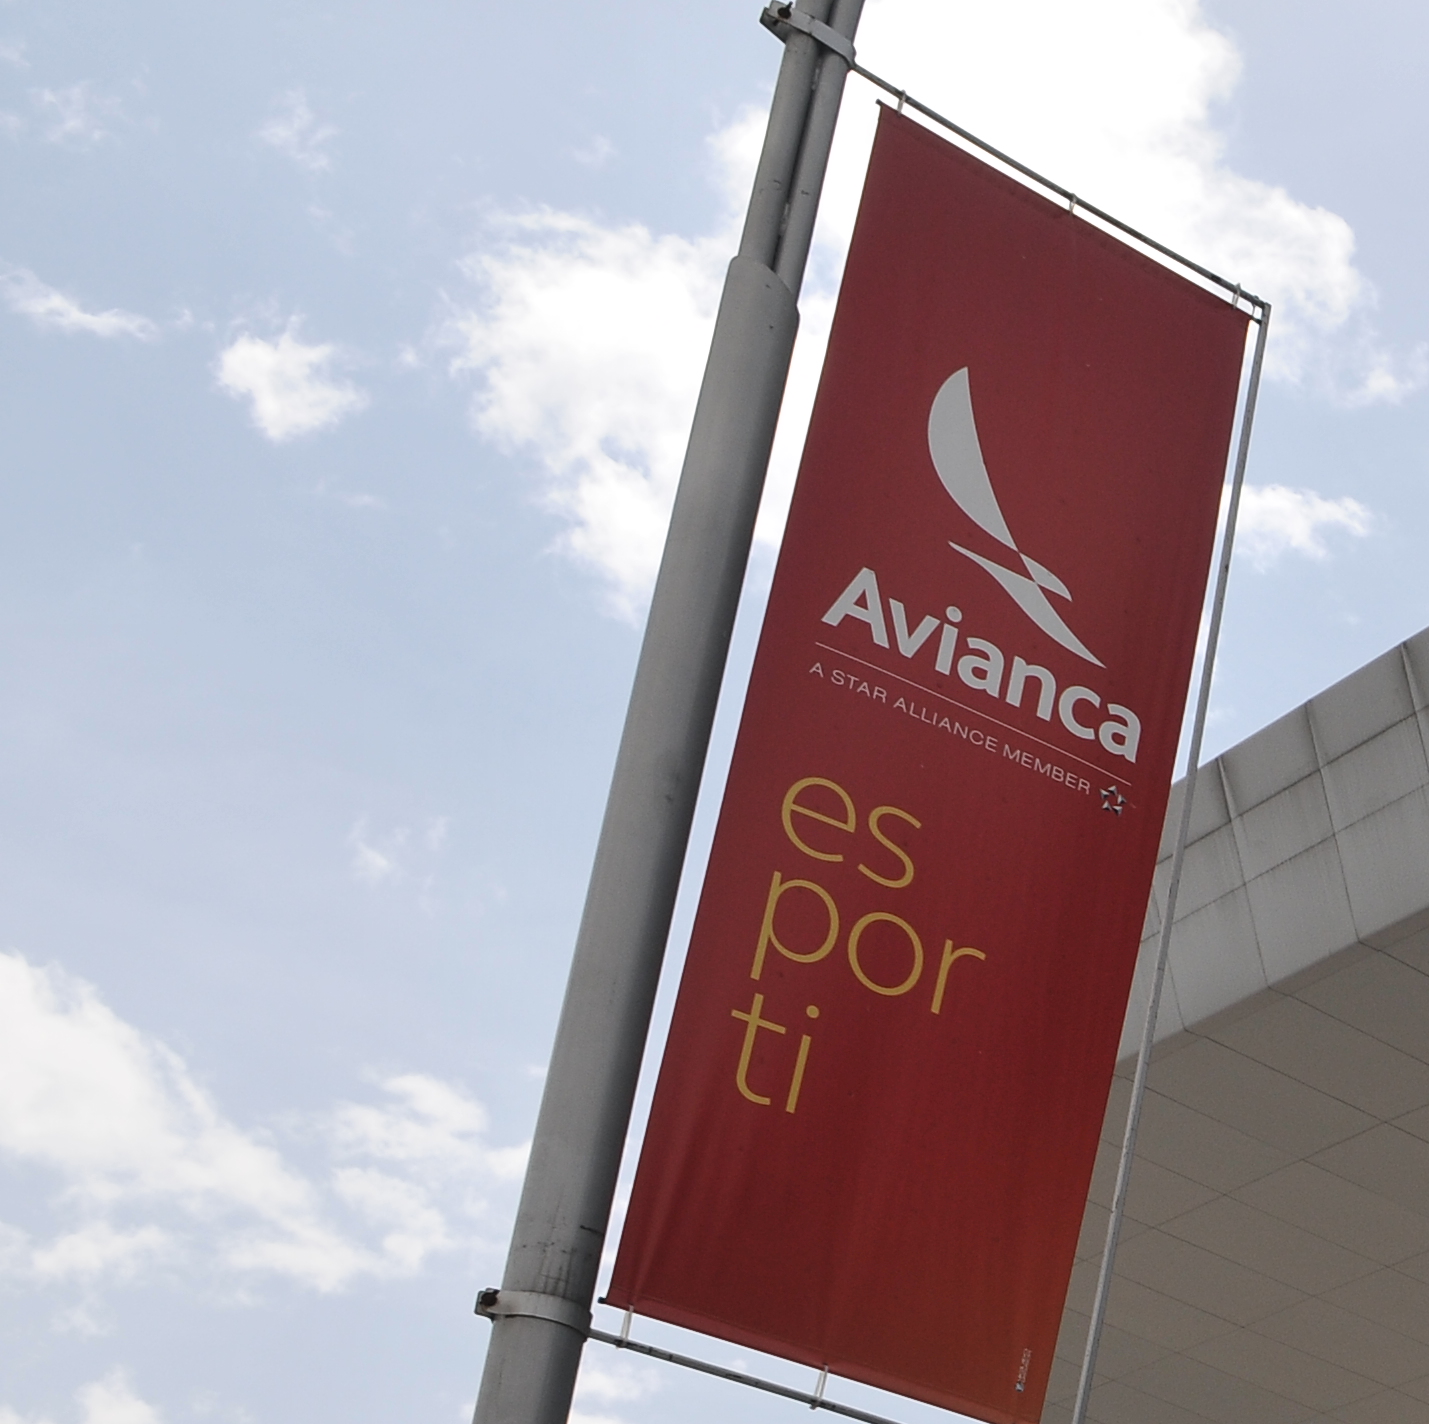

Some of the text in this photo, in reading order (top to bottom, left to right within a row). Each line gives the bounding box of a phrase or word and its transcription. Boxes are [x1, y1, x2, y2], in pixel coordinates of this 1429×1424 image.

[809, 662, 1091, 795] A STAR ALLIANCE MEMBER
[821, 567, 1142, 764] Avianca
[782, 777, 922, 888] es
[750, 870, 986, 1015] por
[731, 993, 820, 1114] ti
